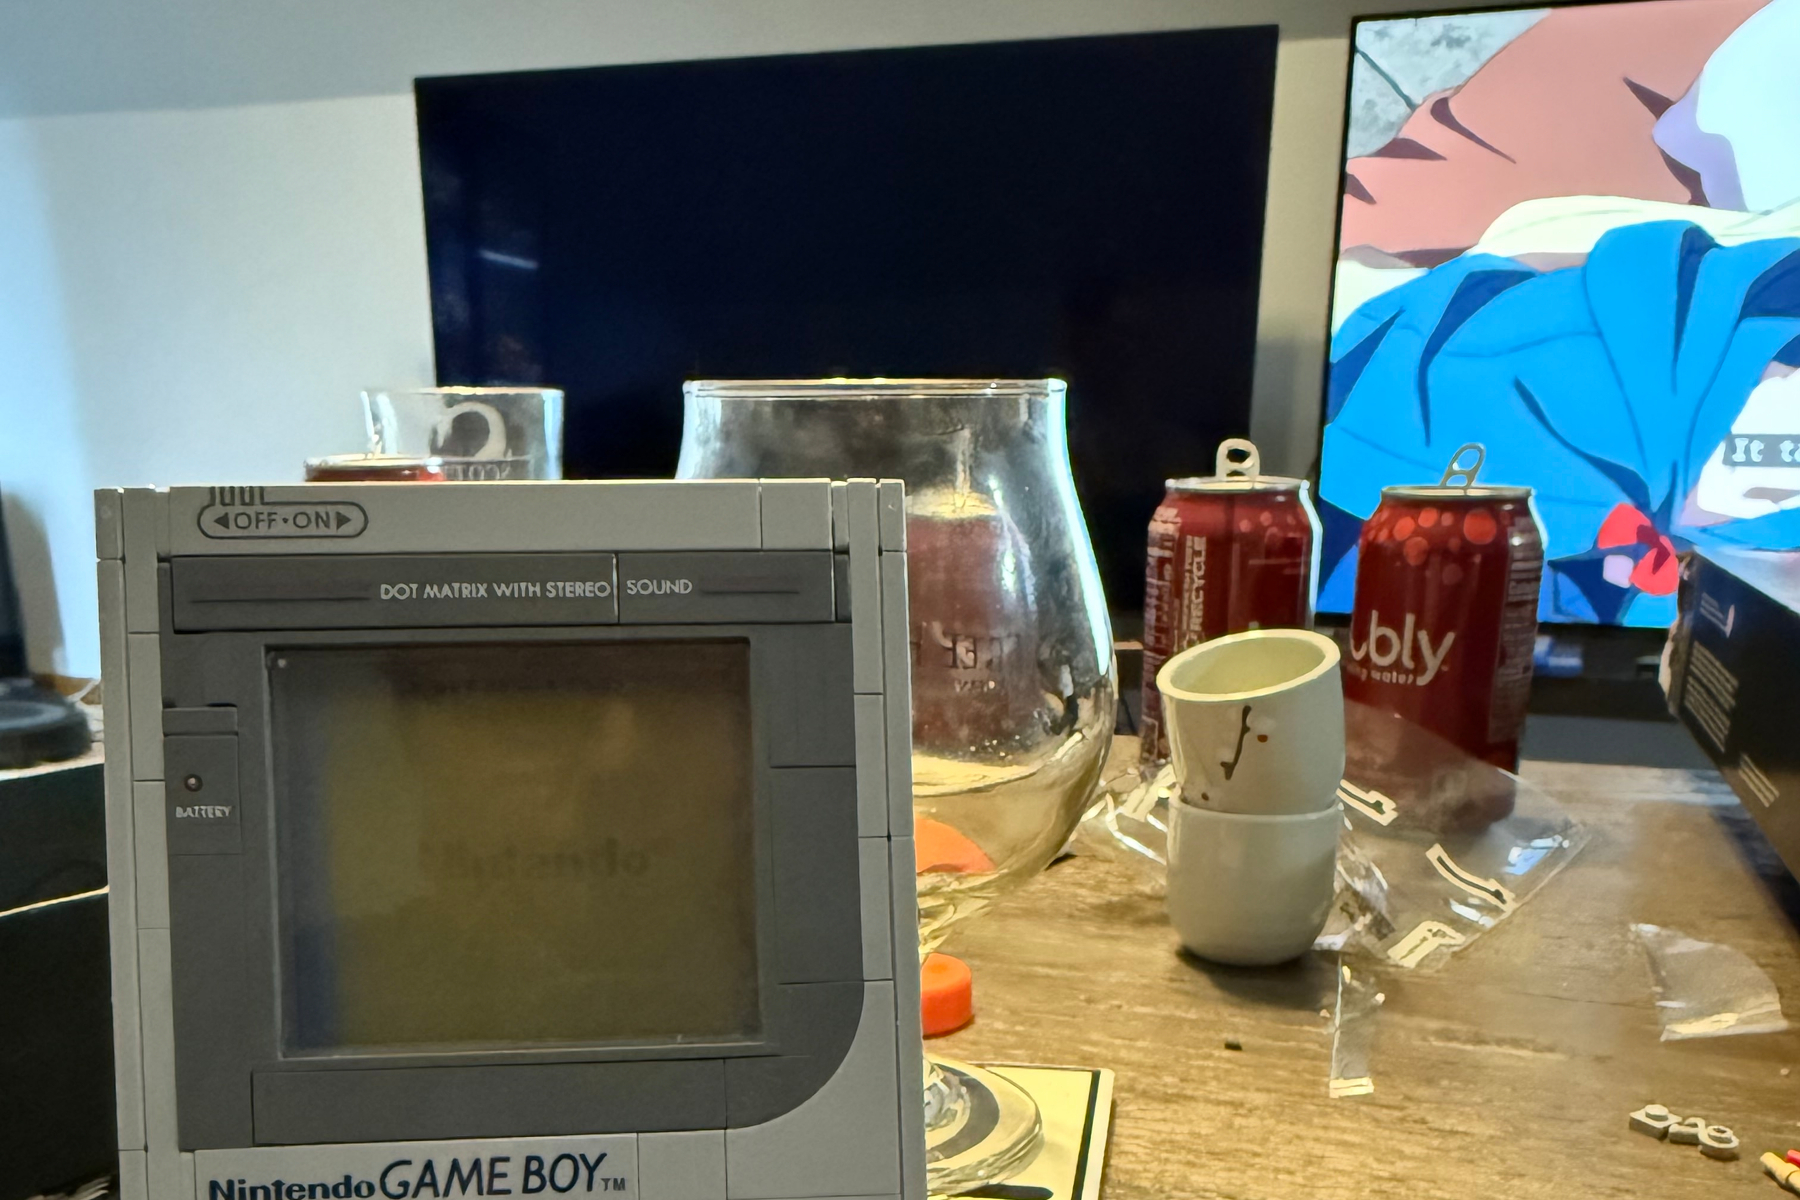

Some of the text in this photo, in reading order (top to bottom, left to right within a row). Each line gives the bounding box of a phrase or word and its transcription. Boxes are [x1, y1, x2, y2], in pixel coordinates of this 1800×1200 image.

[380, 578, 694, 600] DOT MATRIX WITH STEREO SOUND
[175, 804, 233, 819] BATTERY
[379, 1155, 513, 1200] GAME
